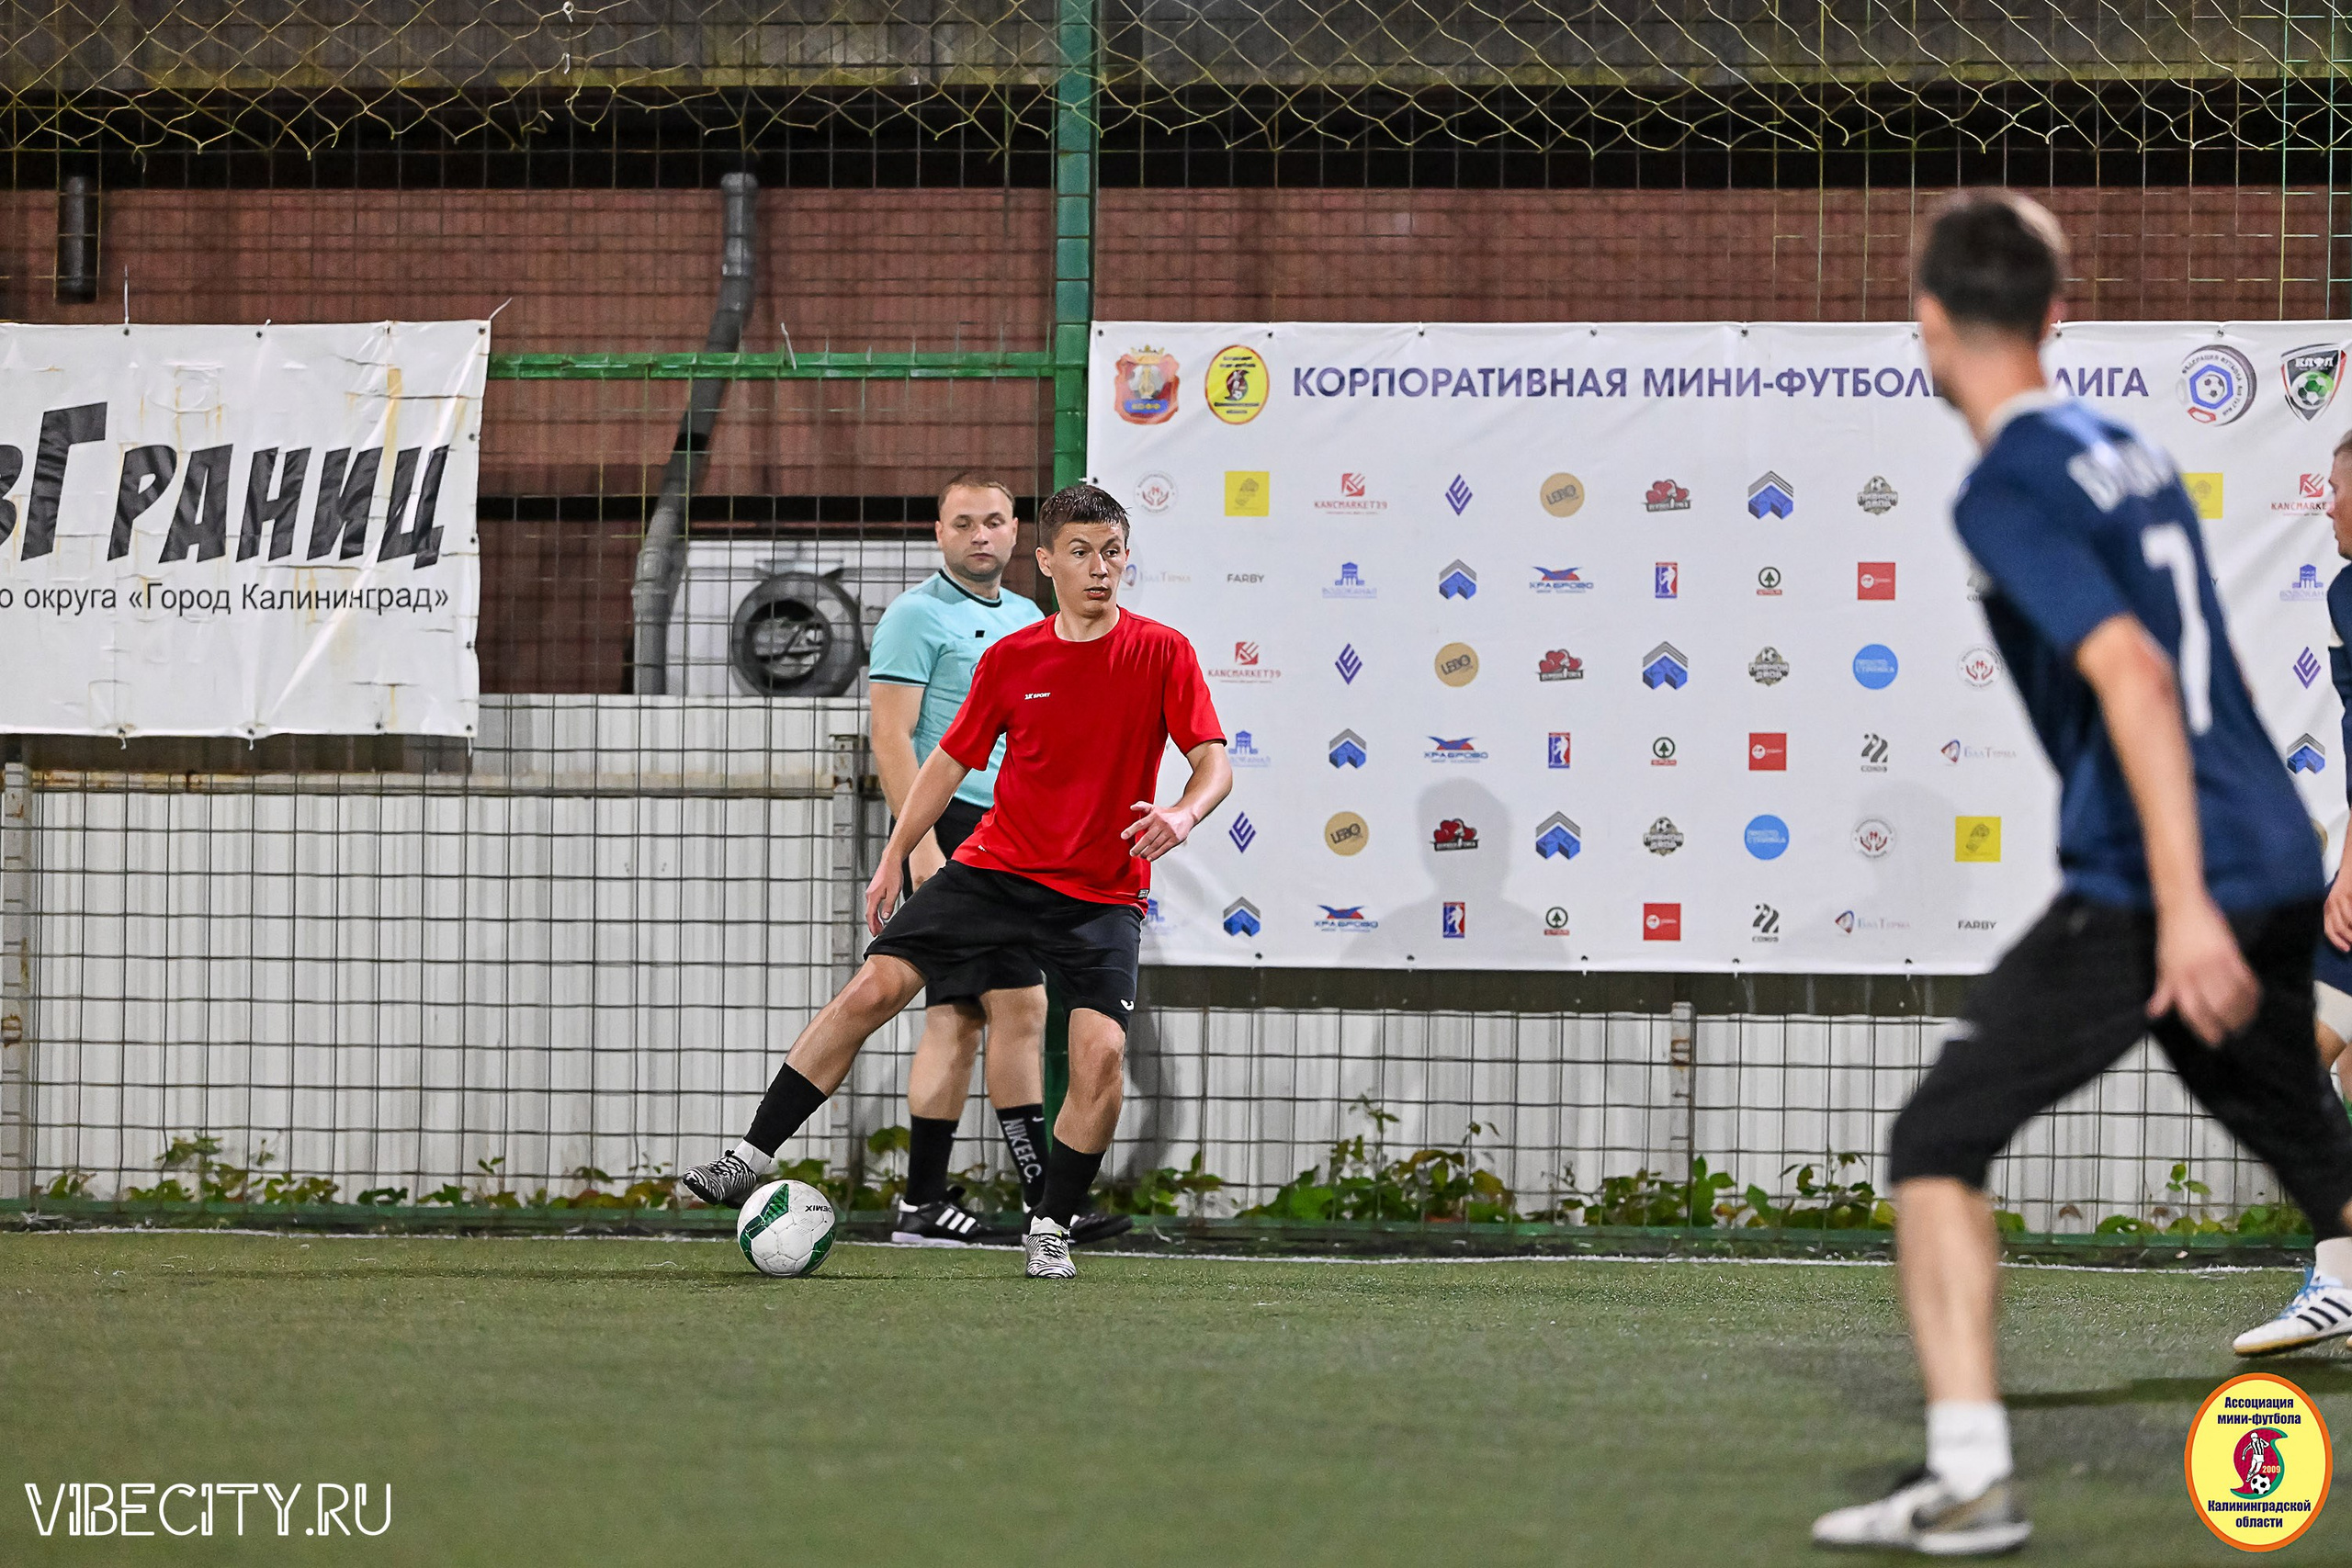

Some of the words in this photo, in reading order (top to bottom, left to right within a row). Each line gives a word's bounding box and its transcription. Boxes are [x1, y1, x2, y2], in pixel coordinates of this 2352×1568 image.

[1294, 367, 1627, 398] КОРПОРАТИВНАЯ
[1644, 367, 1940, 398] МИНИ-ФУТБОЛ
[1227, 574, 1265, 583] FARBY
[24, 588, 117, 616] округа
[129, 582, 232, 615] «Город
[243, 582, 449, 616] Калининград»
[1958, 920, 1997, 930] FARBY
